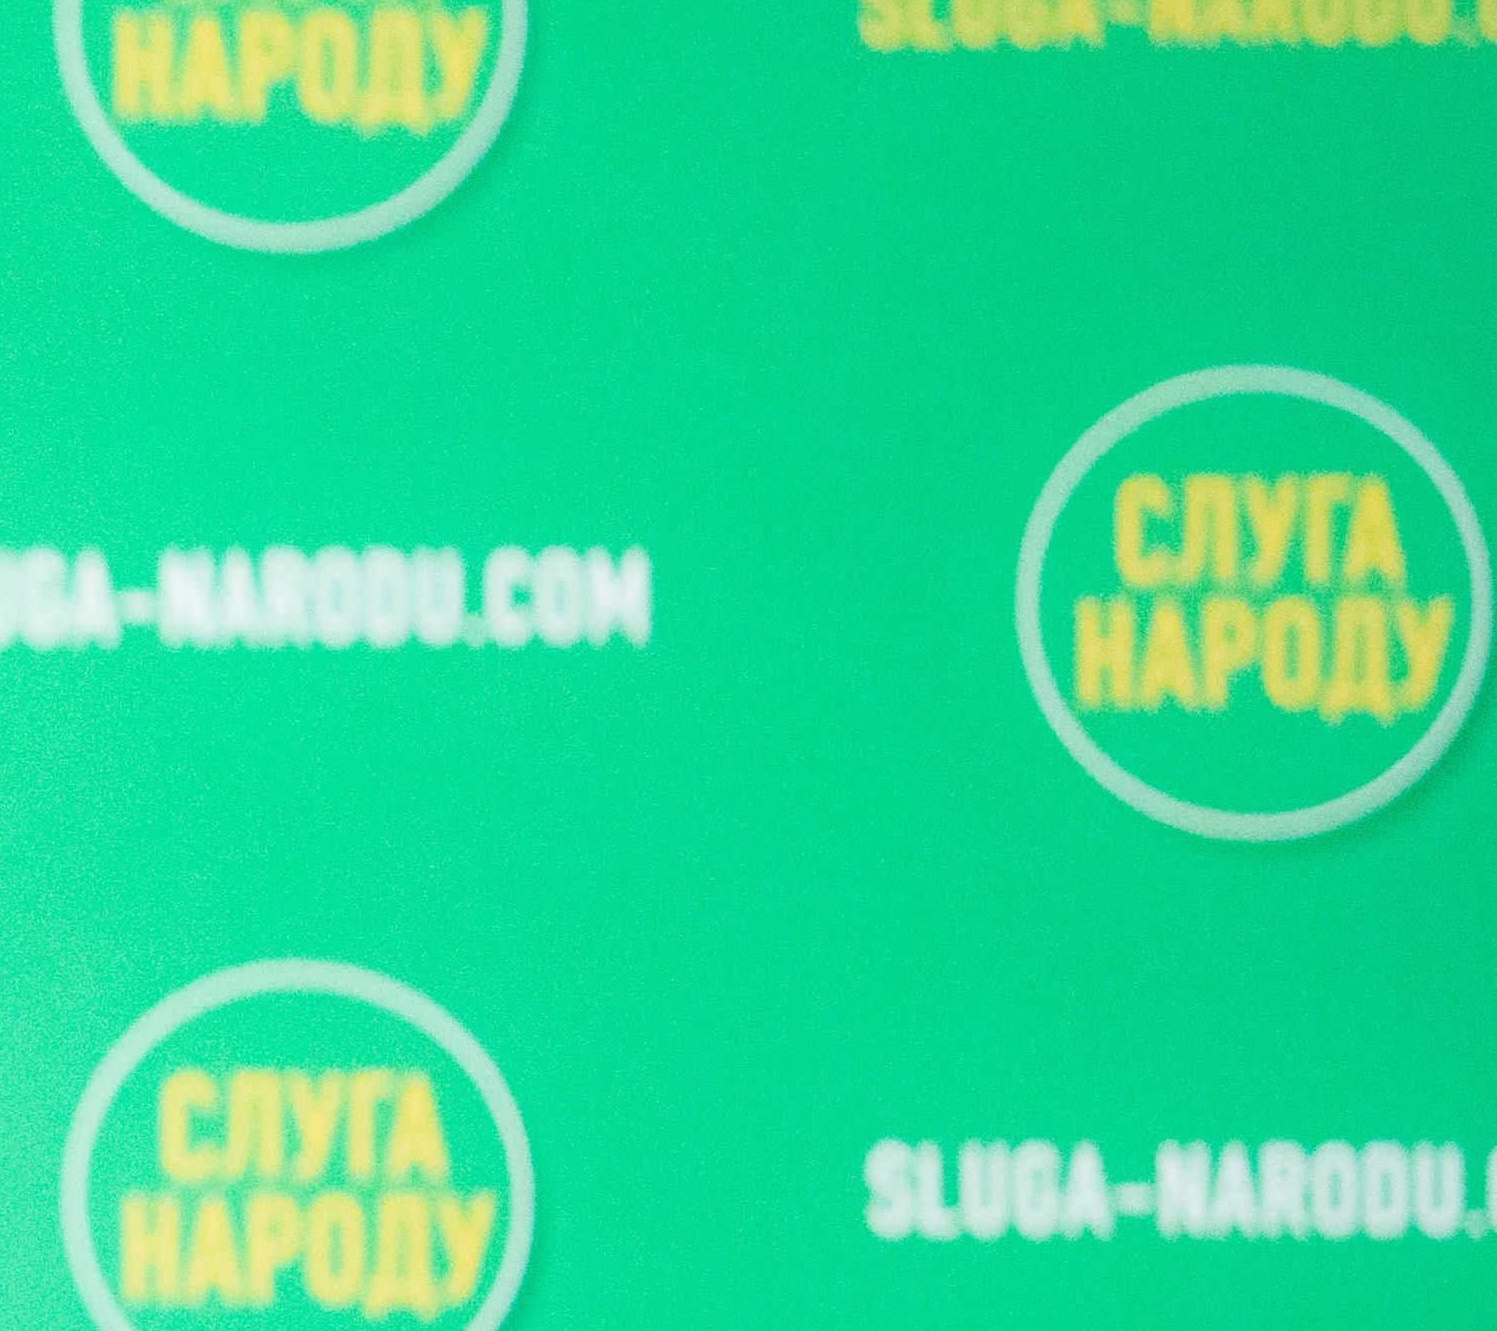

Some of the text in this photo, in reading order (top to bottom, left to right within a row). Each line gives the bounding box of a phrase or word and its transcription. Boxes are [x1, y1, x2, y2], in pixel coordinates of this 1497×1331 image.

[109, 1, 489, 133] НАРОДУ
[1115, 474, 1405, 587] СЛУГА
[1071, 589, 1451, 720] НАРОДУ
[156, 1068, 449, 1183] СЛУГА
[116, 1185, 496, 1317] НАРОДУ
[864, 1140, 1497, 1240] SLUGA-NARODU.
